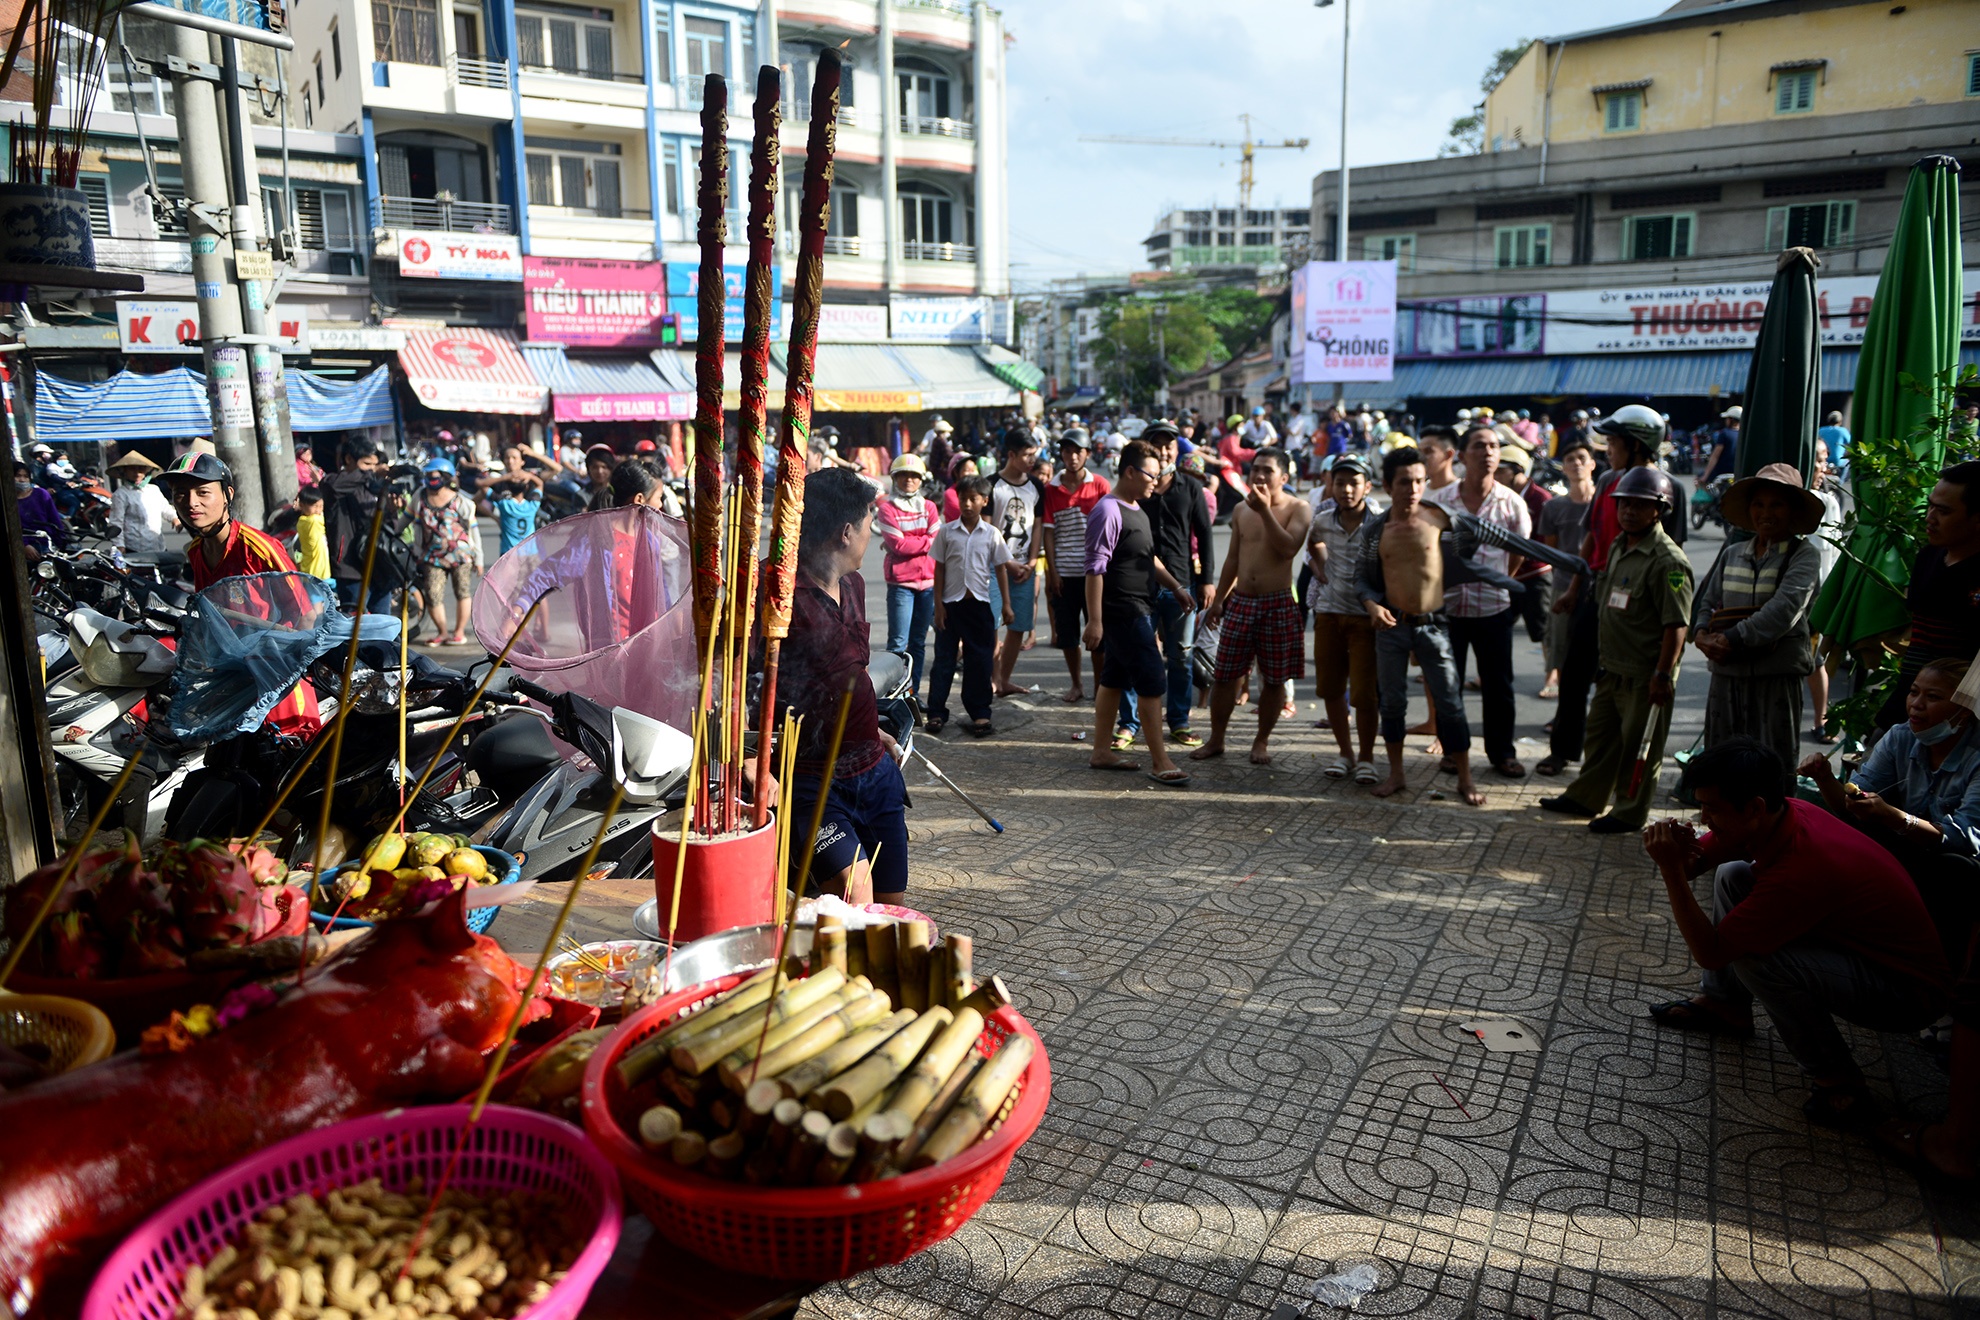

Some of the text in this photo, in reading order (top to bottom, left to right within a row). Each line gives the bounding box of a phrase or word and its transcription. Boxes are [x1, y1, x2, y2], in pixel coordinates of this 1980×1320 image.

[476, 249, 510, 260] NGA
[581, 288, 647, 316] THANH
[649, 291, 661, 317] 3
[1624, 292, 1654, 301] BAN
[1659, 288, 1700, 300] NHÂN
[1705, 287, 1737, 297] DÂN
[898, 309, 961, 324] NHƯ
[1629, 297, 1766, 336] THƯƠNG
[844, 392, 905, 404] NHUNG
[614, 401, 656, 416] THANH
[657, 400, 667, 415] 3
[517, 518, 527, 536] 9
[567, 817, 631, 853] LUIAS
[813, 831, 847, 855] adidas
